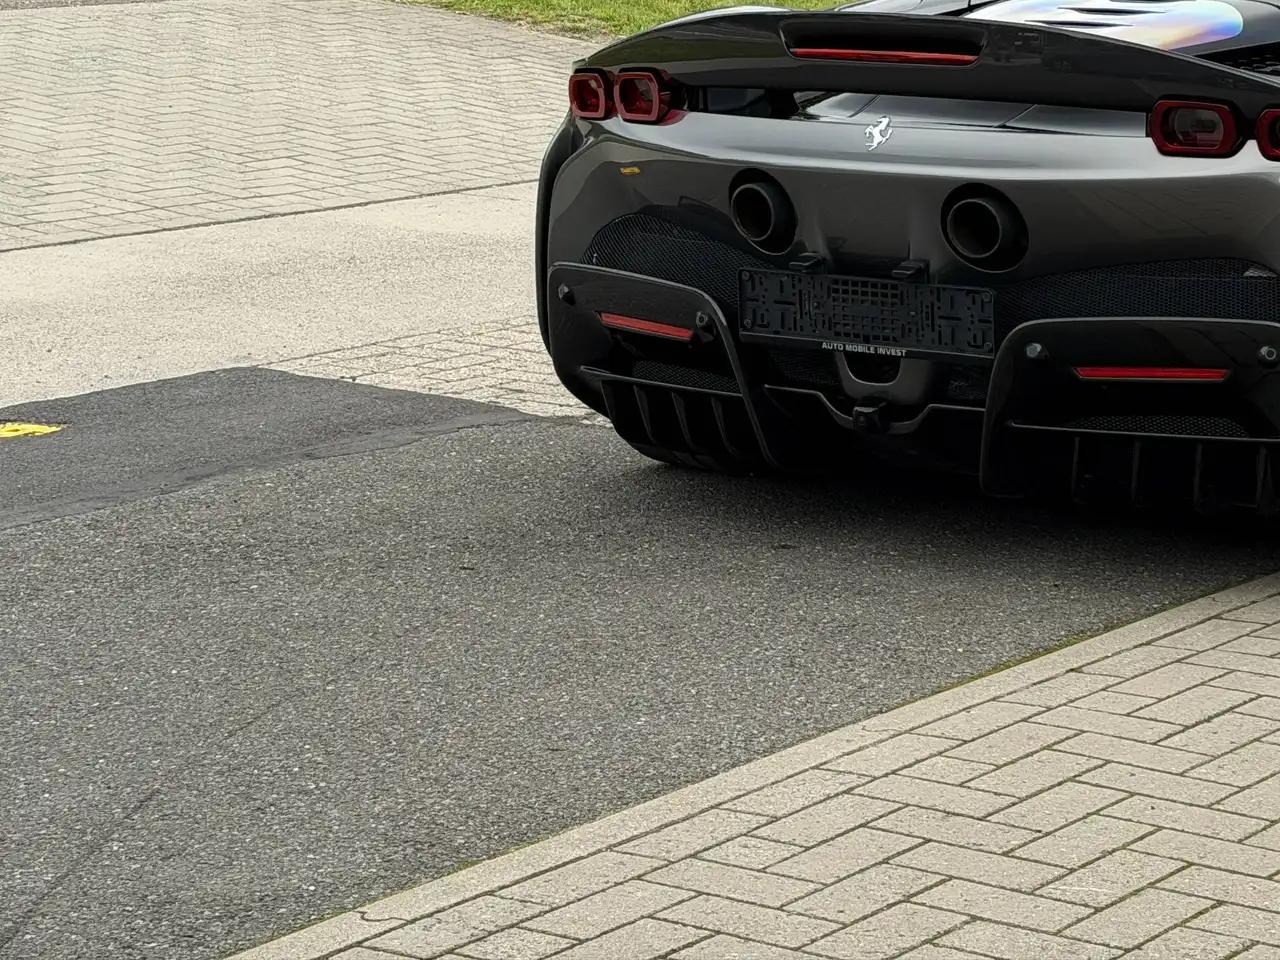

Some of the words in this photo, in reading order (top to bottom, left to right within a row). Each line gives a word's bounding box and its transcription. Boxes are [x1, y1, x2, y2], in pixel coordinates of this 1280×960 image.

[822, 342, 843, 350] AUTO
[845, 344, 876, 353] MOBILE
[877, 347, 907, 356] INVEST
